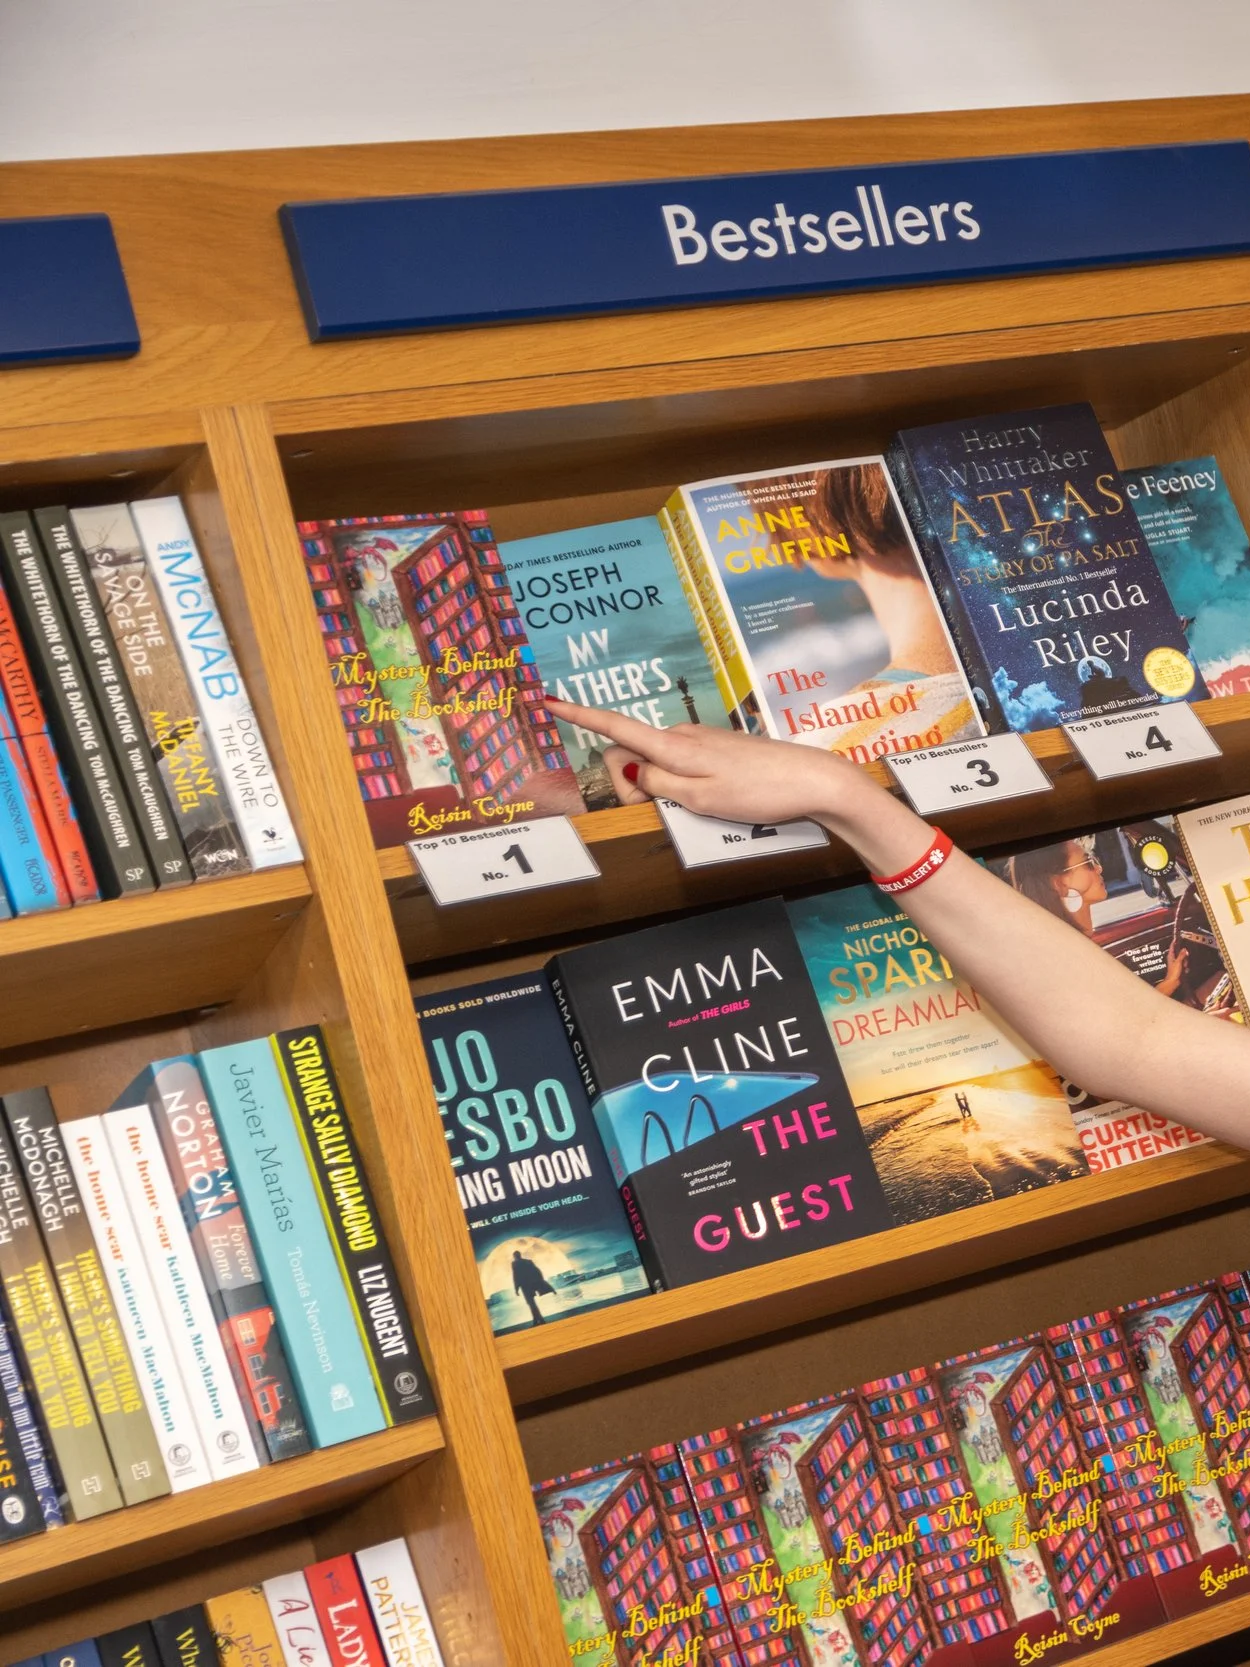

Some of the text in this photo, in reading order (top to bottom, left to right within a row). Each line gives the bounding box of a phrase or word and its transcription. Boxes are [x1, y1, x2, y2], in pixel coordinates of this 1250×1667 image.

[661, 184, 981, 265] Bestsellers
[960, 424, 1043, 452] Harry
[703, 479, 817, 504] THE NUMBER ONE BESTSELLING
[938, 449, 1089, 487] Whittaker
[1141, 470, 1216, 496] Feeney
[717, 506, 810, 543] ANNE
[948, 473, 1123, 542] ATLAS
[157, 539, 191, 551] ANDY
[527, 539, 642, 567] TIMES BESTSELLING AUTHOR
[725, 534, 851, 574] GRIFFIN
[960, 538, 1139, 587] STORY OF PA SALT
[515, 562, 622, 603] JOSEPH
[1002, 585, 1017, 595] The
[1018, 576, 1064, 592] International
[1066, 574, 1079, 584] No.
[1084, 566, 1118, 579] Bestseller
[94, 552, 152, 676] SAVAGE SIDE
[126, 575, 165, 648] ON THE
[525, 585, 663, 629] CONNOR
[988, 580, 1149, 633] Lucinda
[12, 530, 99, 750] THE WHITETHORN OF THE DANCING
[566, 628, 612, 669] MY
[1033, 629, 1132, 668] Riley
[330, 647, 517, 693] Mystery Behind
[767, 668, 828, 696] The
[361, 688, 517, 724] The Bookshelf
[781, 684, 920, 736] Island of
[150, 711, 200, 814] McDANIEL
[174, 716, 219, 797] TIFFANY
[219, 724, 258, 808] THE WIRE
[237, 719, 279, 808] DOWN TO
[891, 742, 988, 766] Top 10 Bestsellers
[950, 759, 999, 793] No. 3
[88, 754, 130, 848] TOM McCAUGHREN
[475, 796, 534, 824] Coyne
[414, 824, 530, 851] Top 10 Bestsellers
[482, 843, 534, 881] No. 1
[903, 861, 931, 886] ALERT
[846, 917, 893, 933] THE GLOBAL
[423, 984, 541, 1019] BOOKS SOLD WORLDWIDE
[611, 947, 784, 1023] EMMA
[668, 999, 750, 1028] Author of THE GIRLS
[431, 1030, 498, 1102] JO
[641, 1016, 809, 1093] CLINE
[196, 1101, 236, 1197] GRAHAM
[230, 1063, 294, 1232] Javier Marías
[288, 1036, 378, 1251] STRANGE SALLY DIAMOND
[743, 1101, 837, 1157] THE
[1078, 1111, 1168, 1151] CURTIS
[13, 1116, 64, 1231] MCDONAGH
[38, 1126, 80, 1217] MICHELLE
[163, 1090, 222, 1220] NORTON
[508, 1145, 593, 1195] MOON
[693, 1175, 854, 1253] GUEST
[208, 1234, 233, 1281] Home
[229, 1223, 255, 1281] Forever
[287, 1246, 333, 1374] Tomás Nevinson
[358, 1263, 409, 1358] LIZ NUGENT
